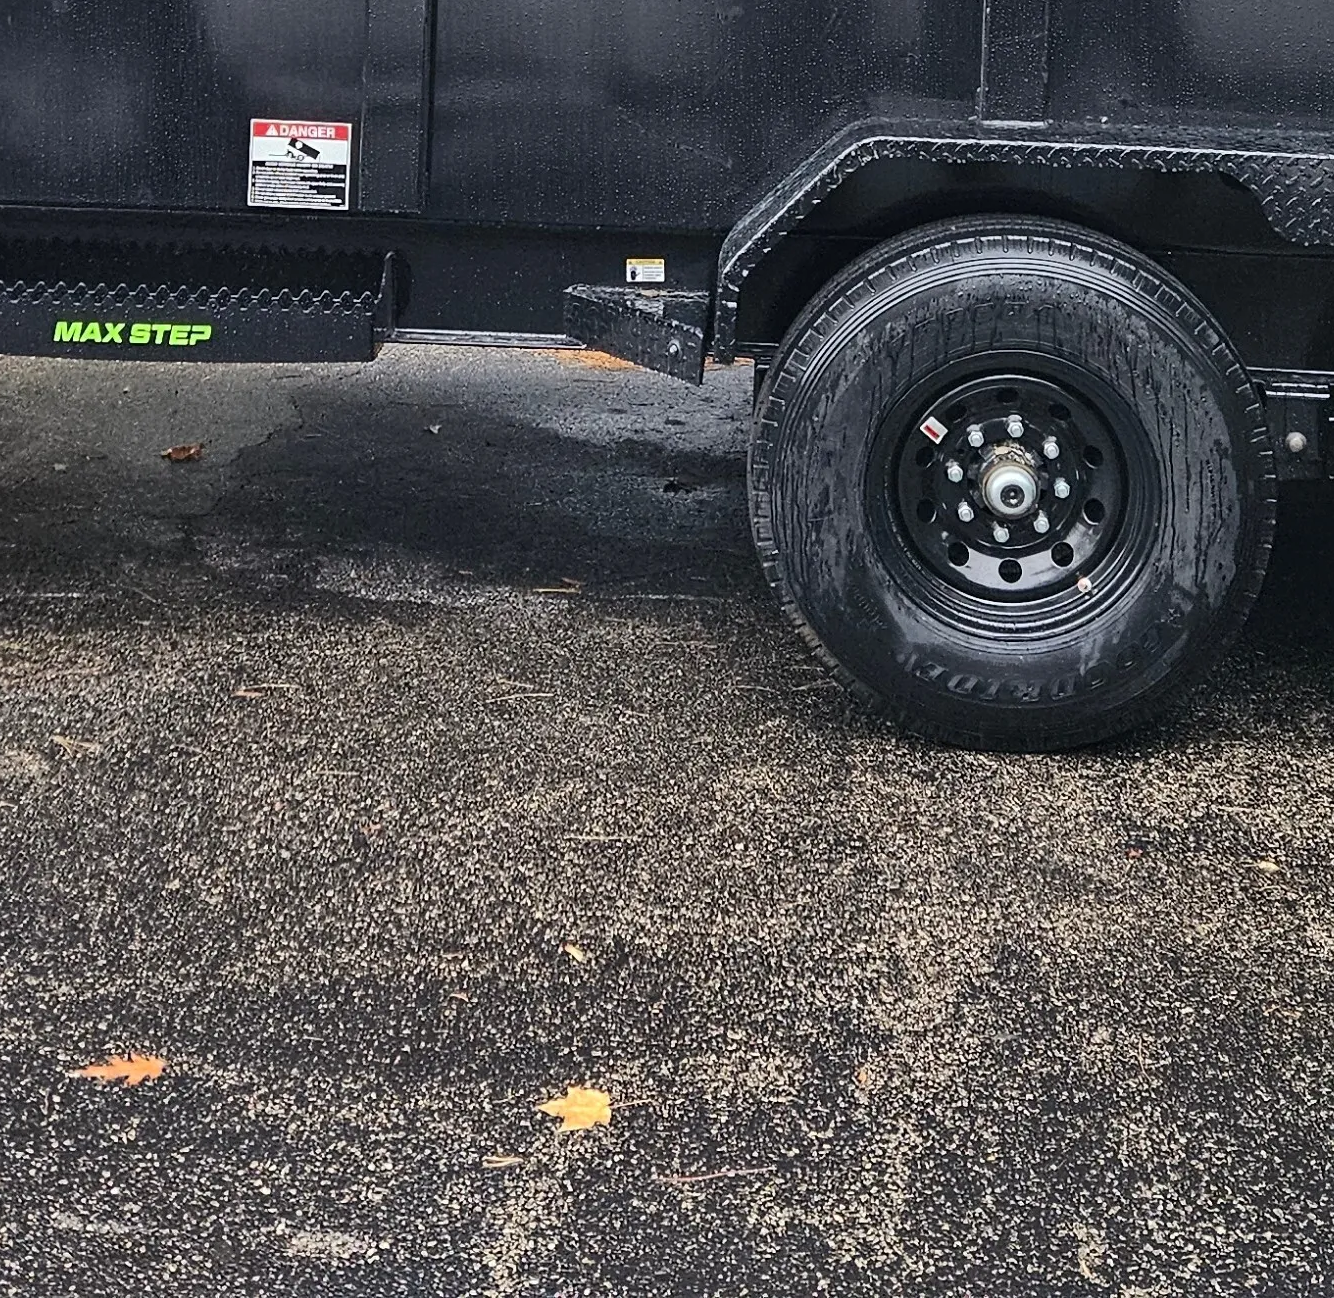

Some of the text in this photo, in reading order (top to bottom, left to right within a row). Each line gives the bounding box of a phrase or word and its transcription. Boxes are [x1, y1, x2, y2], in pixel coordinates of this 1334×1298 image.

[279, 126, 336, 139] DANGER
[53, 320, 212, 346] MAX STEP
